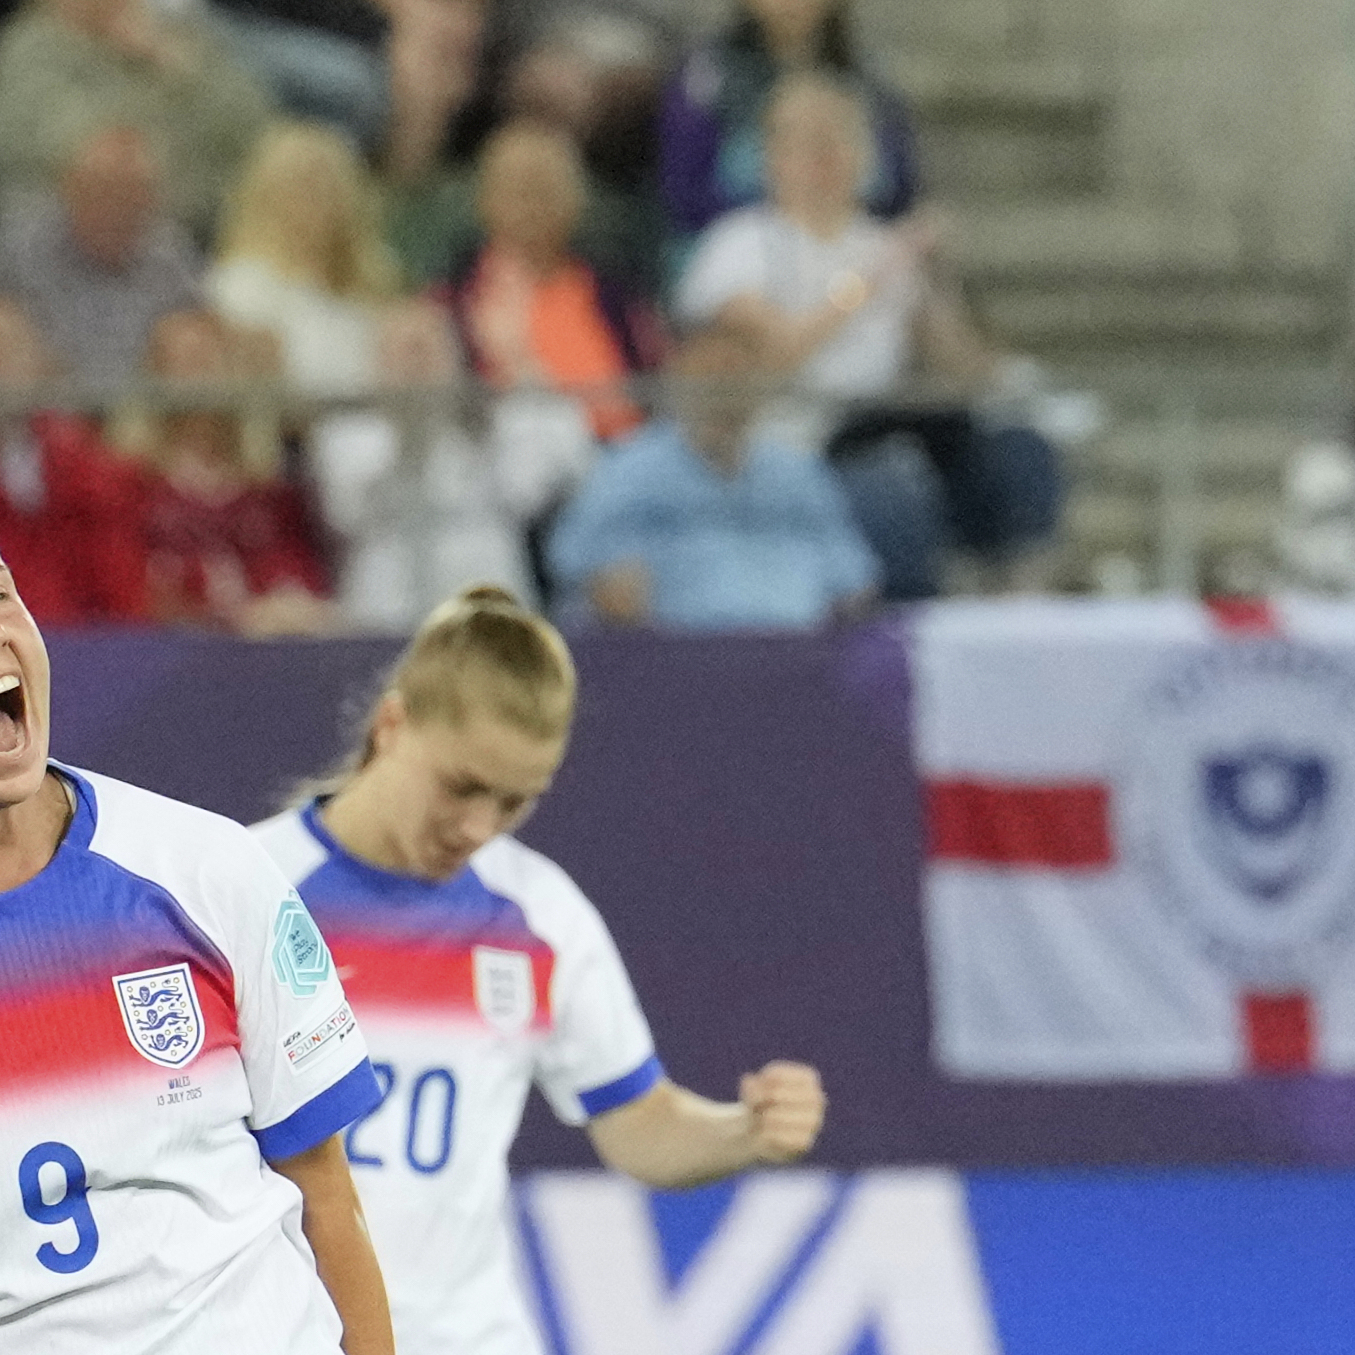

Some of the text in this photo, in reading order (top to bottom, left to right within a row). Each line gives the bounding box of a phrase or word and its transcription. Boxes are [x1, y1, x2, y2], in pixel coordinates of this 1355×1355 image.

[283, 1030, 302, 1048] UEFA
[168, 1075, 191, 1089] WALES
[156, 1094, 165, 1106] 13
[167, 1091, 184, 1105] JULY
[345, 1062, 457, 1175] 20
[18, 1140, 100, 1274] 9
